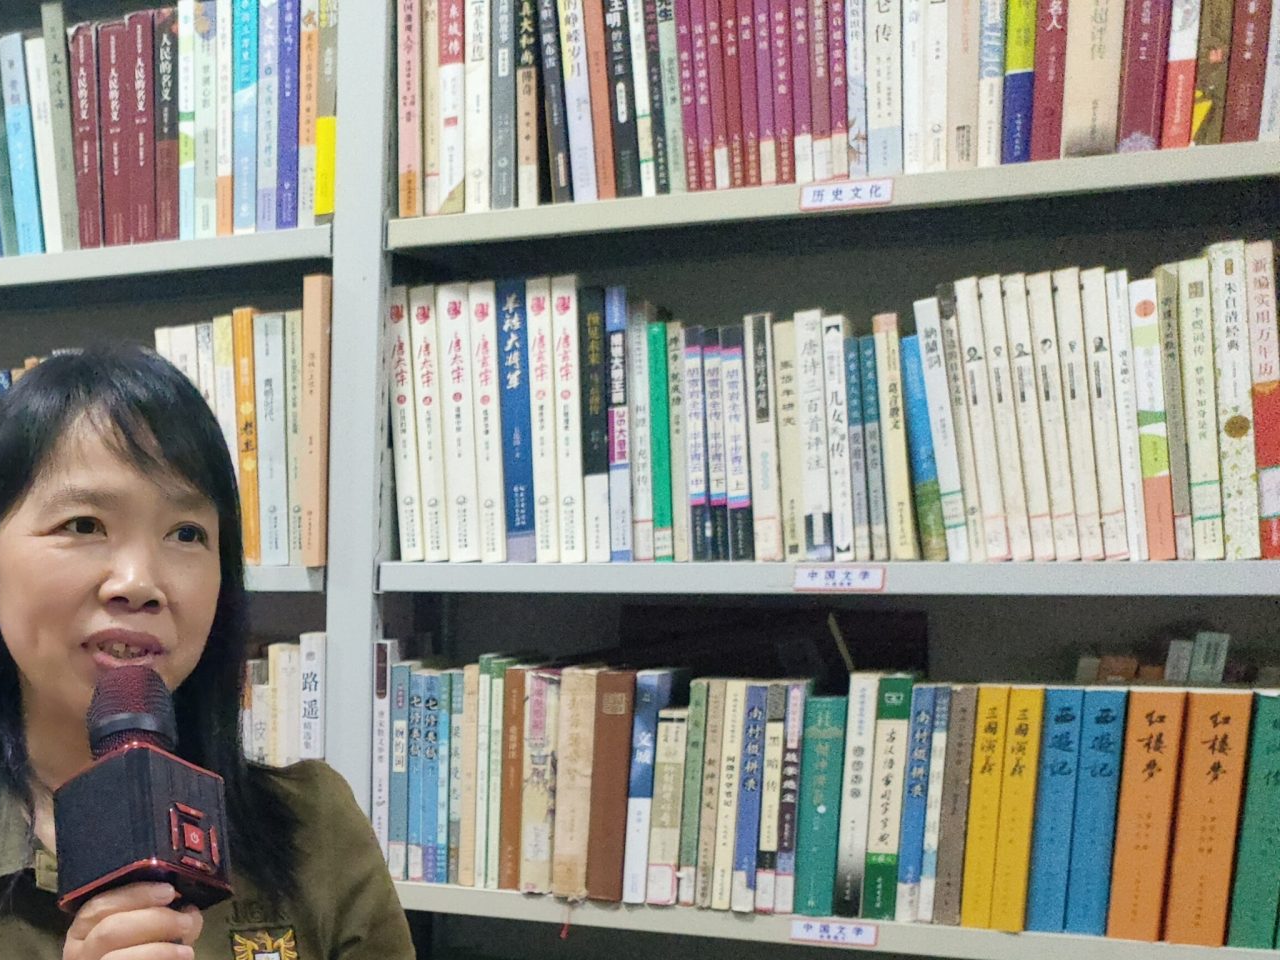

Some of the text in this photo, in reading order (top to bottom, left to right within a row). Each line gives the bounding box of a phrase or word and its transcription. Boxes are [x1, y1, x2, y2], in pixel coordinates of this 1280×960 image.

[78, 66, 91, 121] 人民的名义
[107, 67, 120, 122] 人民的名义
[134, 57, 147, 113] 人民的名义
[159, 33, 174, 102] 人民的名义
[812, 185, 882, 201] 历史文化
[1224, 281, 1241, 352] 朱自清经典
[1251, 258, 1274, 375] 新编实用万年历
[807, 570, 870, 582] 中国文学
[301, 671, 319, 719] 路遥
[766, 735, 779, 792] 黑暗传
[877, 727, 898, 846] 古汉语常用字字典
[803, 924, 864, 937] 中国文学
